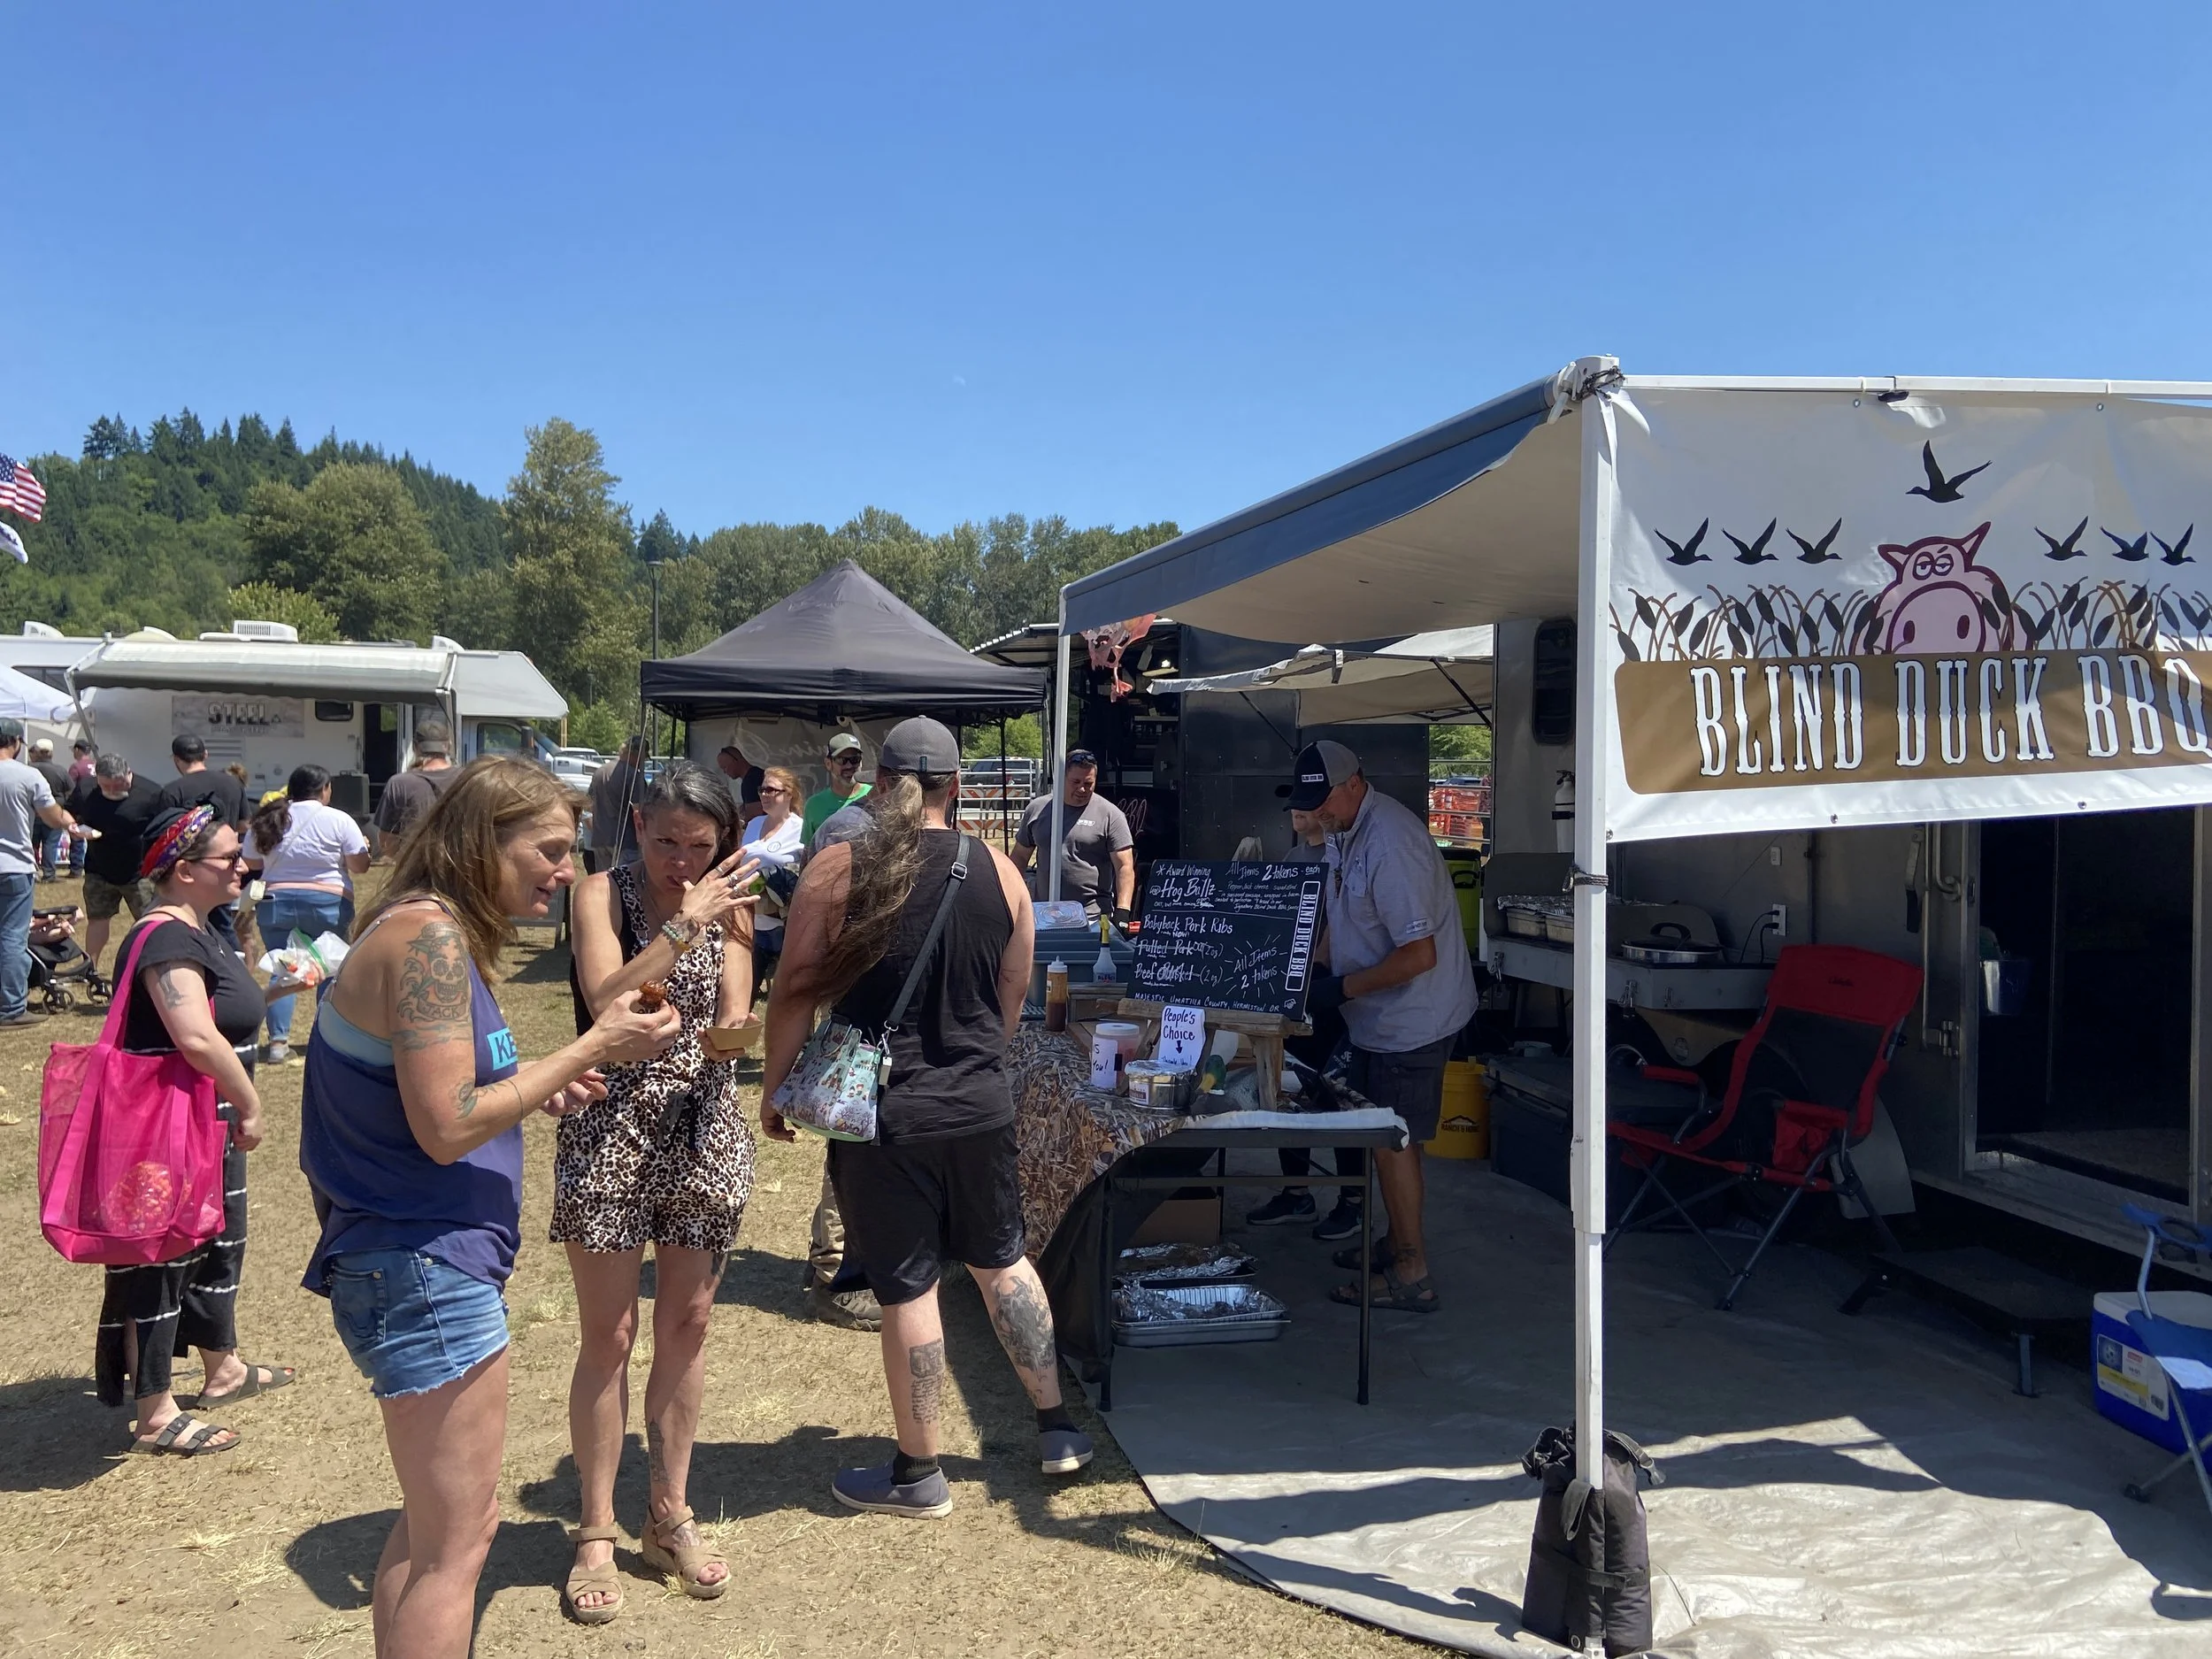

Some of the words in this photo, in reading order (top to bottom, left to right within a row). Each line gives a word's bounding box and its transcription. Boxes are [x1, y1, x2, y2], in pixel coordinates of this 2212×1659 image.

[208, 702, 270, 726] STEEL
[1690, 661, 1863, 777] BLIND
[1894, 656, 2056, 769] DUCK
[2077, 653, 2212, 758] BBQ
[1165, 864, 1187, 876] Award
[1187, 864, 1211, 879] Winning
[1225, 861, 1240, 876] All
[1238, 865, 1260, 880] Items
[1262, 864, 1272, 881] 2
[1272, 865, 1299, 879] tokens
[1305, 864, 1320, 875] each
[1160, 878, 1183, 902] Hog
[1299, 894, 1317, 924] BLIND
[1143, 914, 1180, 933] Babyback
[1185, 917, 1207, 933] Pork
[1210, 918, 1233, 933] Ribs
[1138, 939, 1170, 956] Pulled
[1173, 939, 1193, 956] Pork
[1293, 927, 1311, 954] DUCK
[1233, 955, 1248, 973] All
[1248, 947, 1277, 967] Items
[1288, 957, 1306, 977] BBQ
[1134, 962, 1157, 979] Beef
[1240, 974, 1249, 989] 2
[1251, 964, 1278, 984] tokens
[1134, 992, 1165, 1003] MAJESTIC
[427, 1005, 460, 1018] JACK
[1164, 1008, 1195, 1027] People's
[1163, 1025, 1195, 1041] Choice
